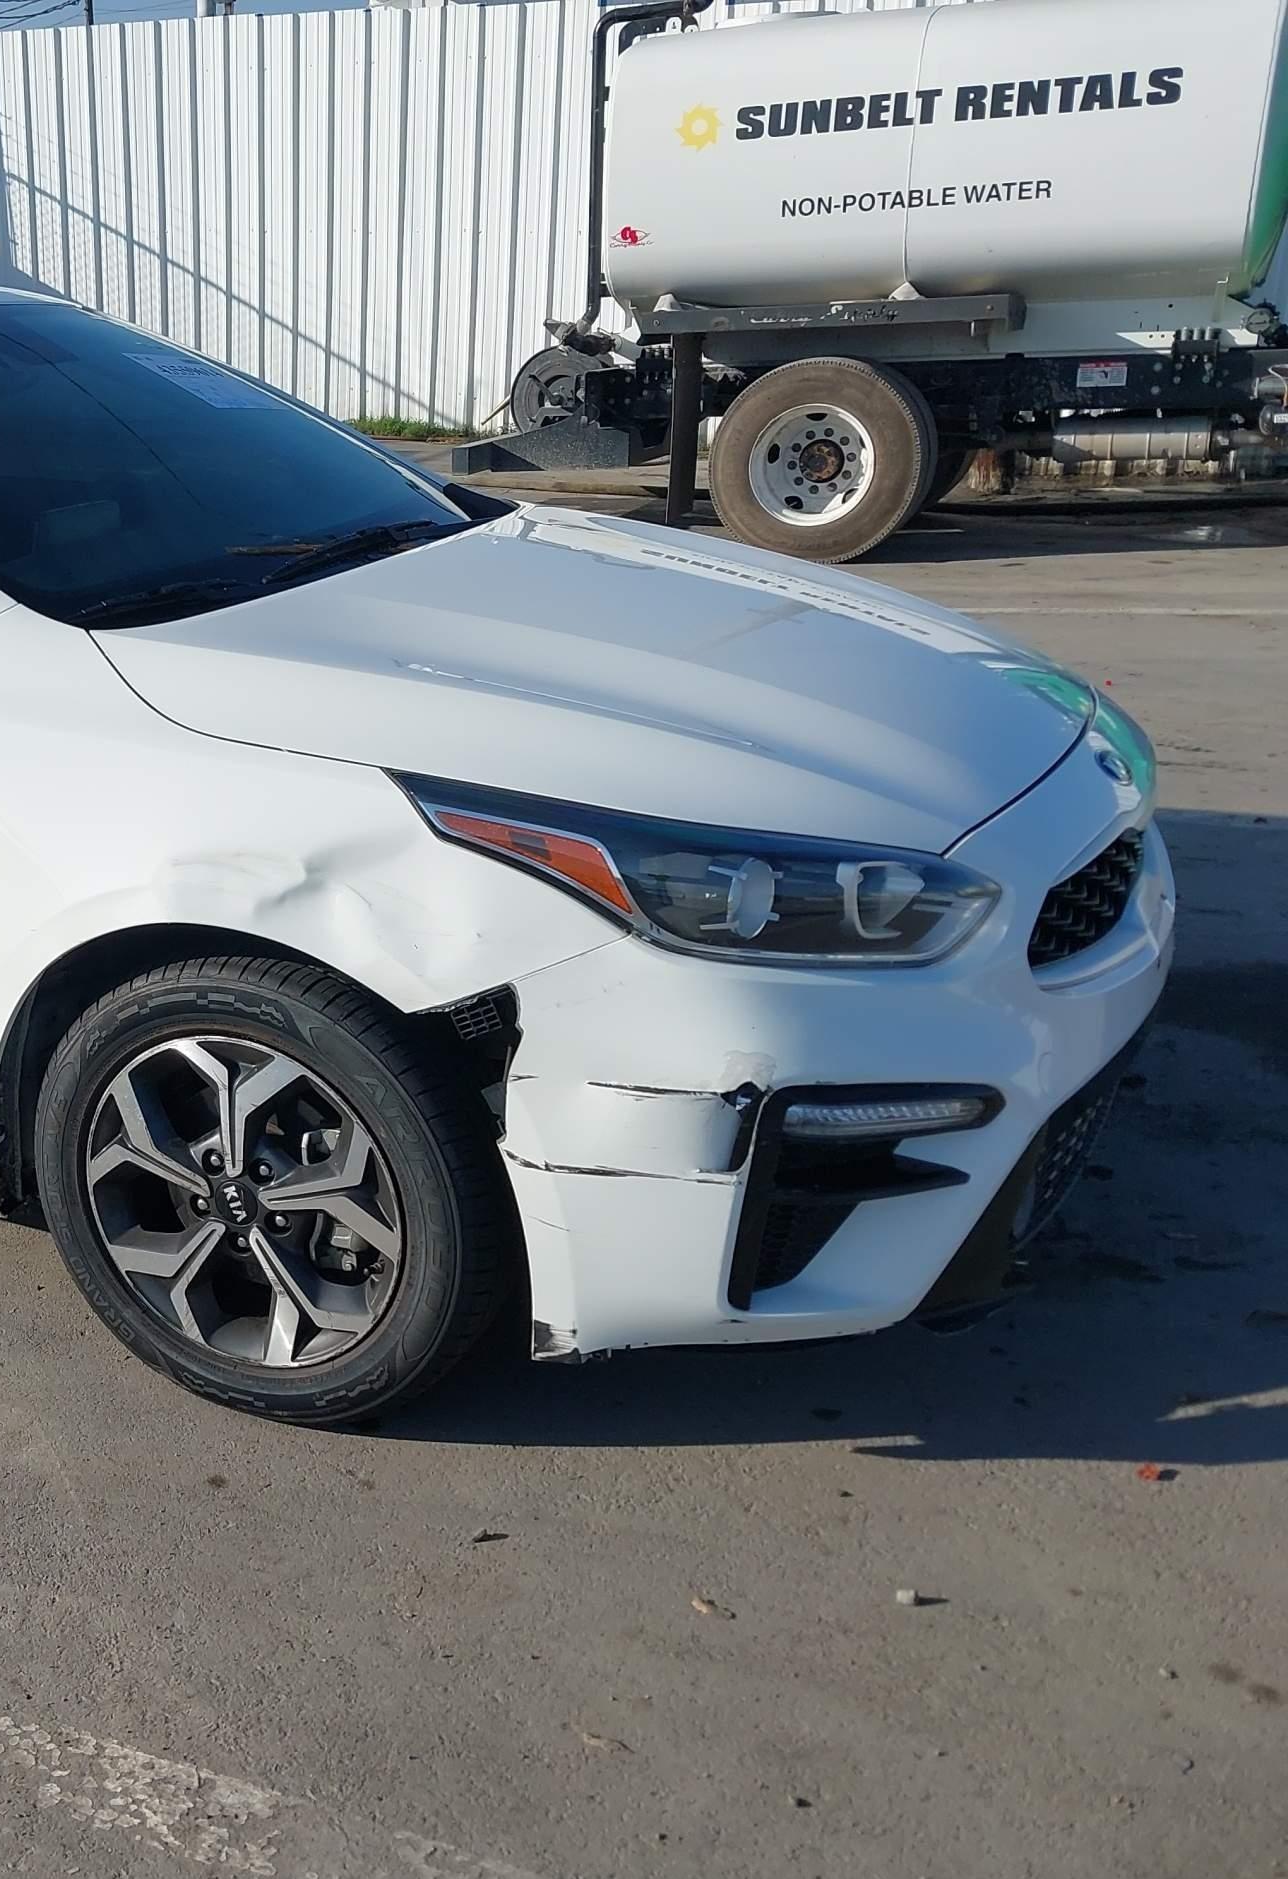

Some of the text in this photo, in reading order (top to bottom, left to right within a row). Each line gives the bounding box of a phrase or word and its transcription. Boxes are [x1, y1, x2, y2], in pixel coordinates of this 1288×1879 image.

[735, 66, 1184, 141] SUNBELT RENTALS
[781, 179, 1053, 218] NON-POTABLE WATER
[223, 1185, 248, 1223] KIA
[69, 1256, 136, 1344] GRAND
